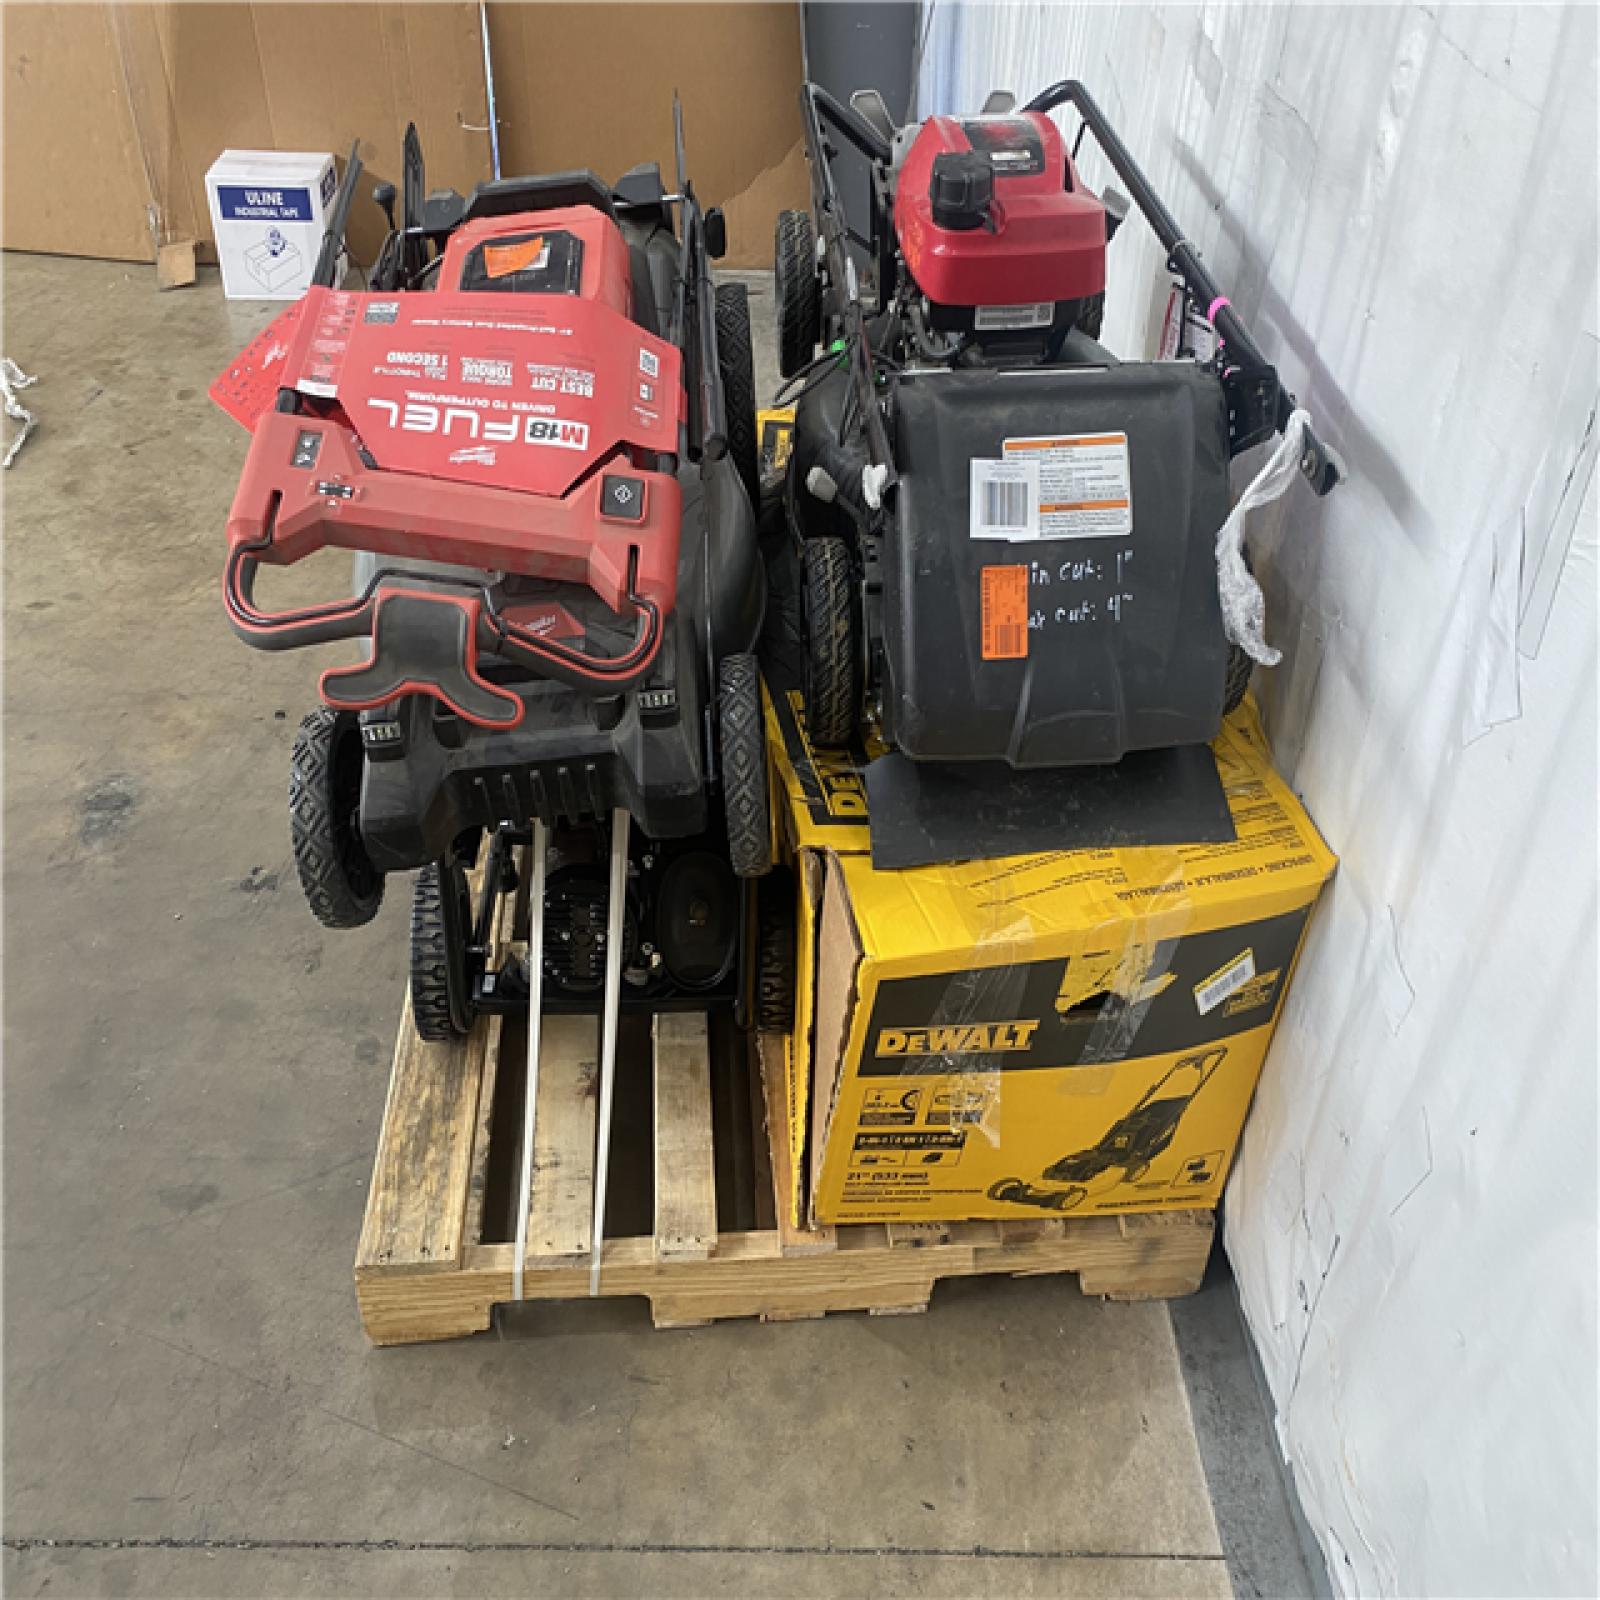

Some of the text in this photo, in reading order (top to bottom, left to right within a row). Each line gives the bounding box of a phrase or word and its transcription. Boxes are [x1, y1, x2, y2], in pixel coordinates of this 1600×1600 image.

[244, 189, 284, 206] ULINE
[234, 206, 299, 218] INDUSTRIAL TAPE
[386, 351, 441, 366] SECOND
[492, 399, 508, 411] TO
[511, 401, 556, 415] DRIVEN
[367, 397, 586, 446] M18 FUEL
[1031, 560, 1050, 585] in
[874, 1020, 1040, 1059] DEWALT
